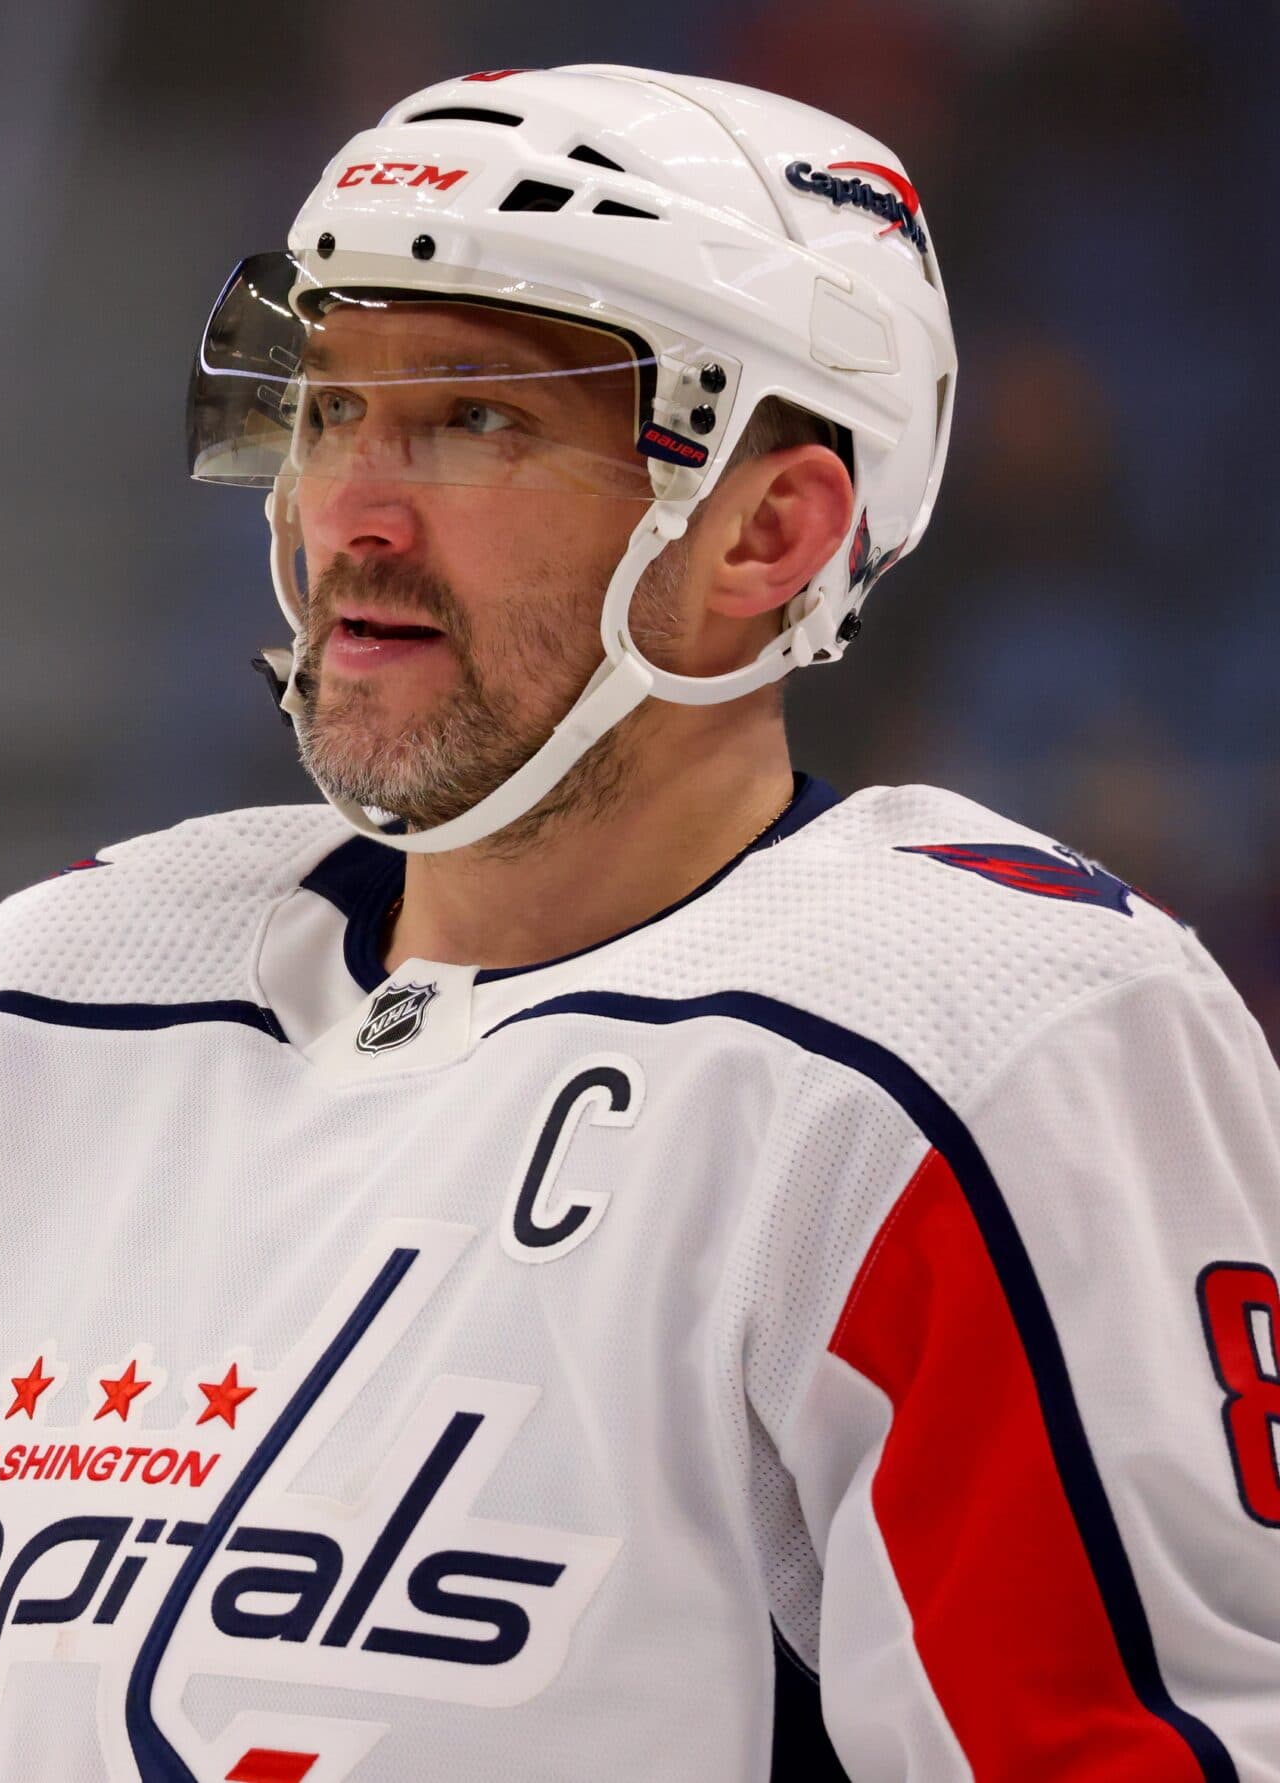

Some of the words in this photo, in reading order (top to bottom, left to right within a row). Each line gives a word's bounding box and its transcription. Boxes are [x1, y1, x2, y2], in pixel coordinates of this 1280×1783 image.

[337, 163, 468, 191] CCM
[366, 998, 418, 1041] NHL
[513, 1066, 631, 1248] C
[1196, 1260, 1280, 1529] 8
